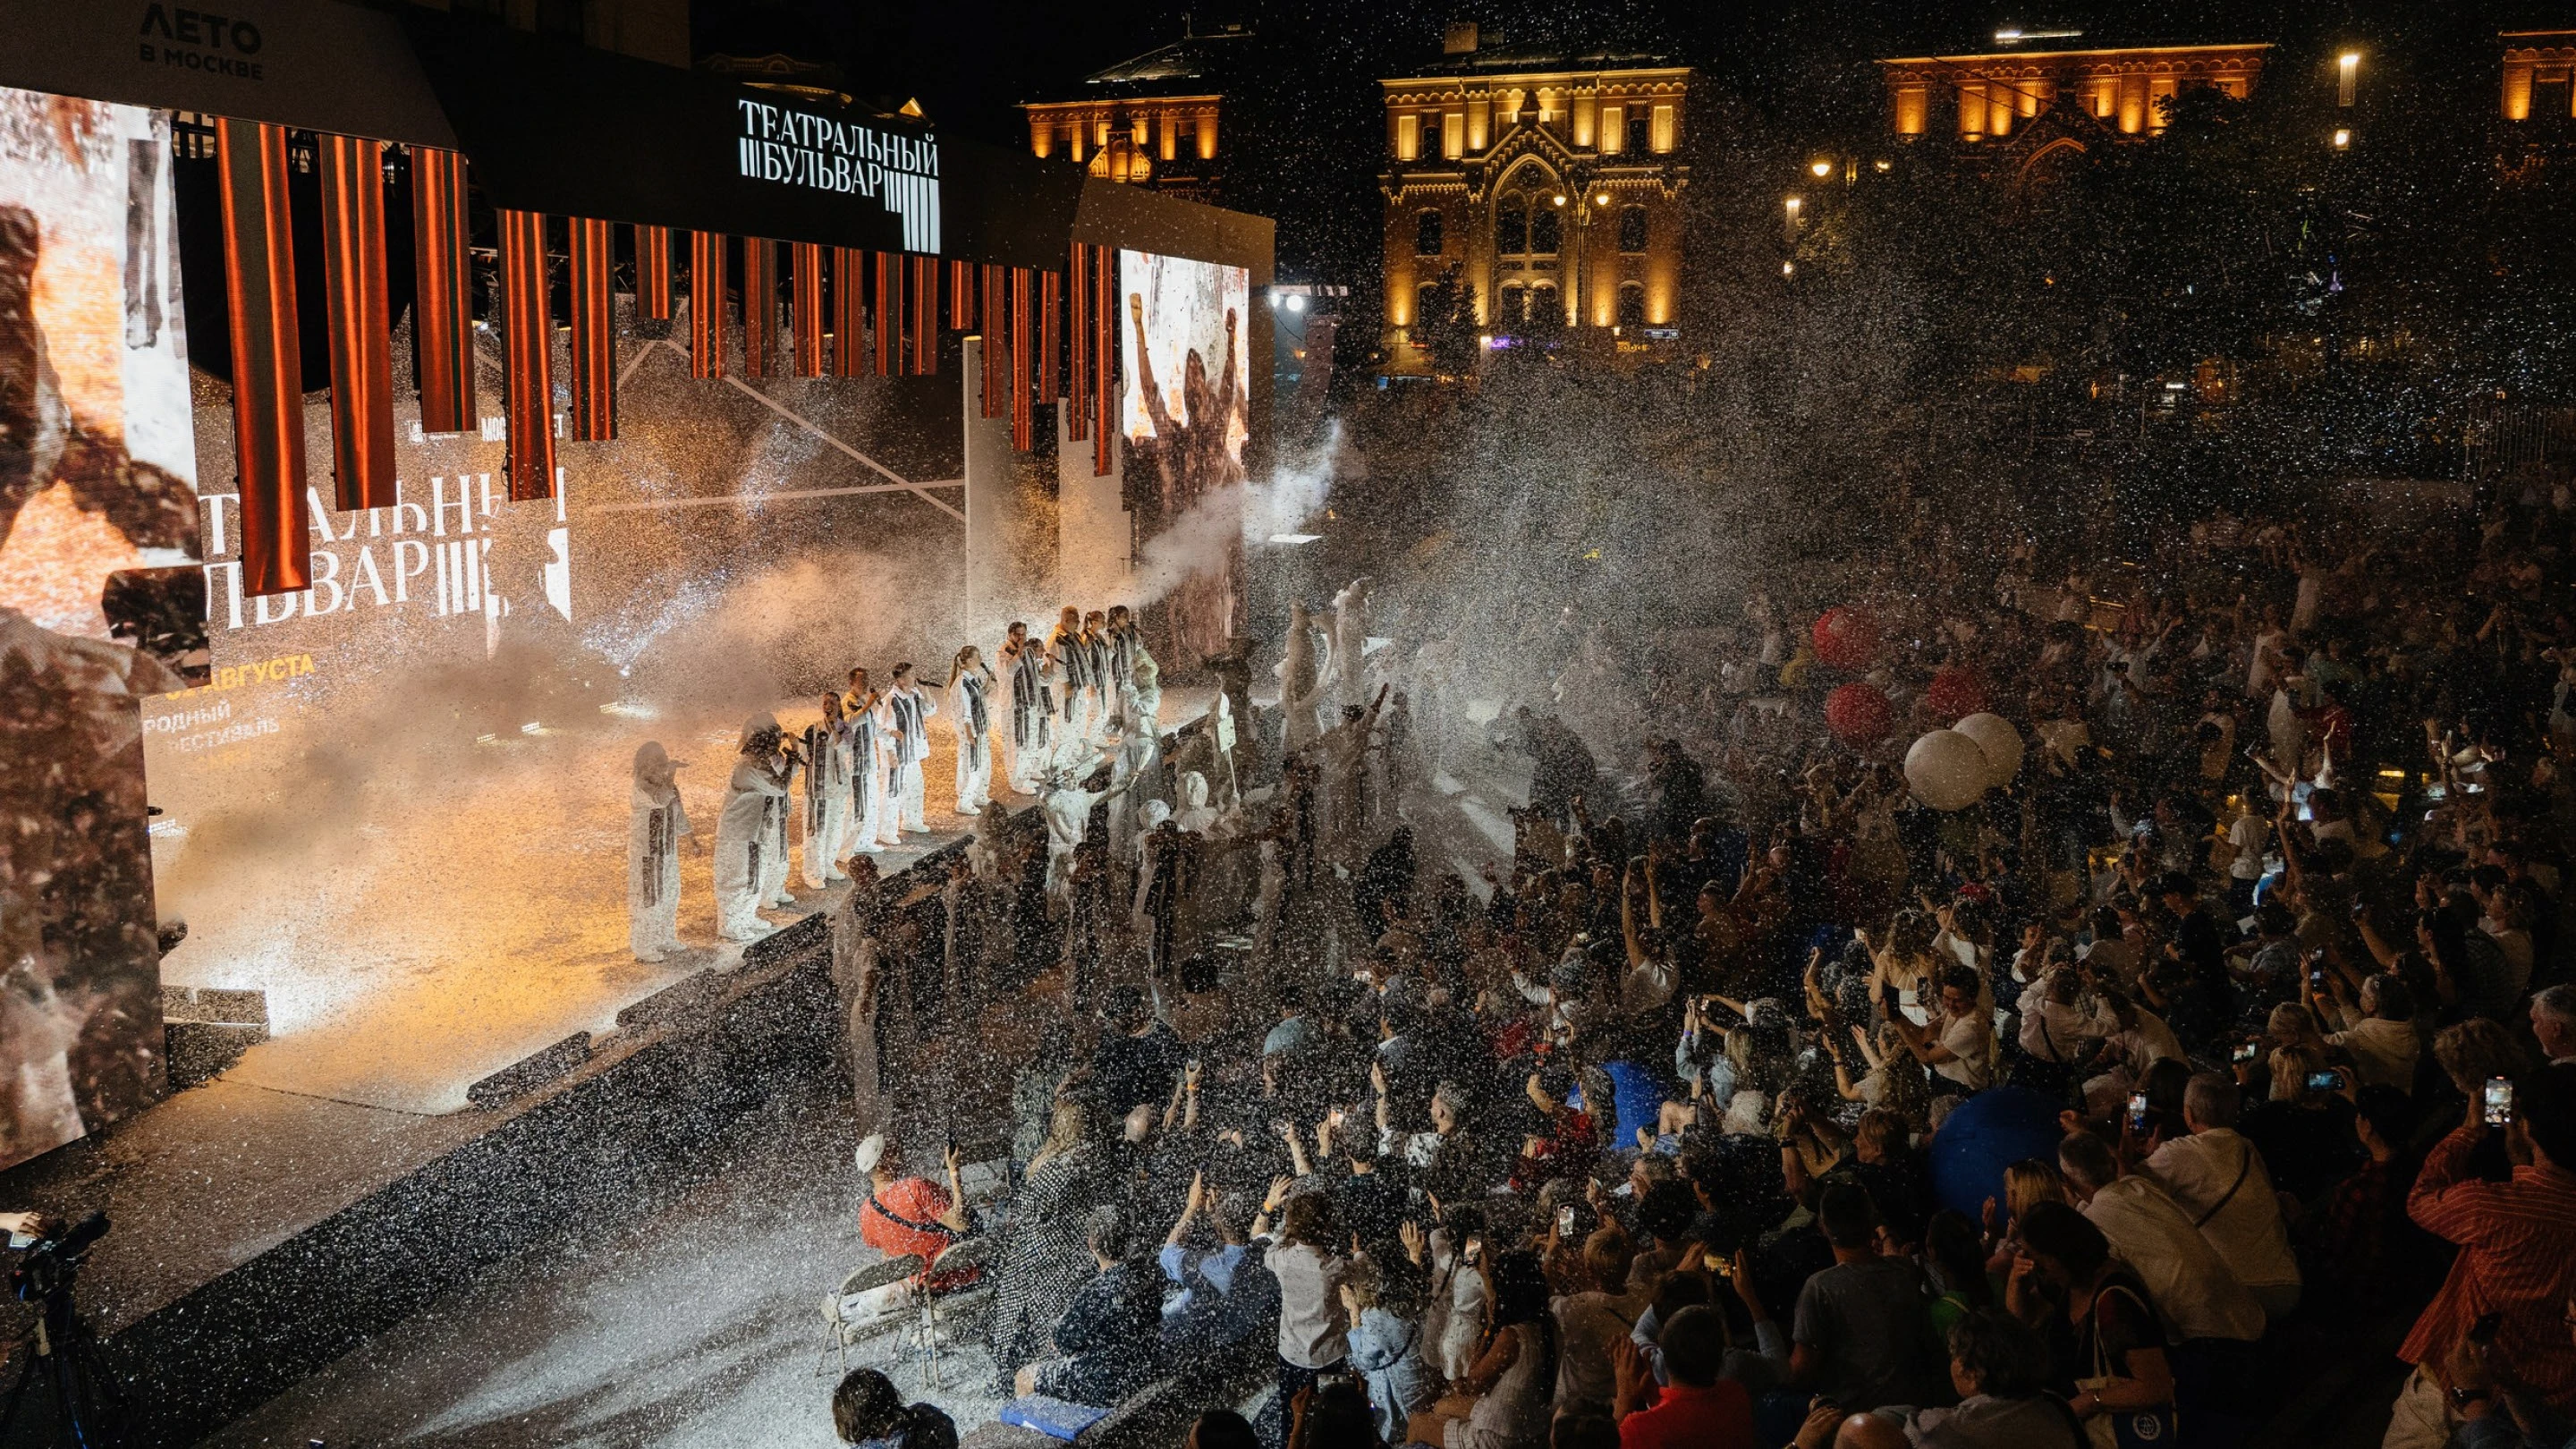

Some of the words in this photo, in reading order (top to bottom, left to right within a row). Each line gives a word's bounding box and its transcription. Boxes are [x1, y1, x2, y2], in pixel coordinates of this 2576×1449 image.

[140, 3, 262, 55] ЛЕТО
[140, 44, 156, 62] В
[163, 48, 264, 80] МОСКВЕ
[738, 98, 939, 177] ТЕАТРАЛЬНЫЙ
[762, 141, 883, 198] БУЛЬВАР
